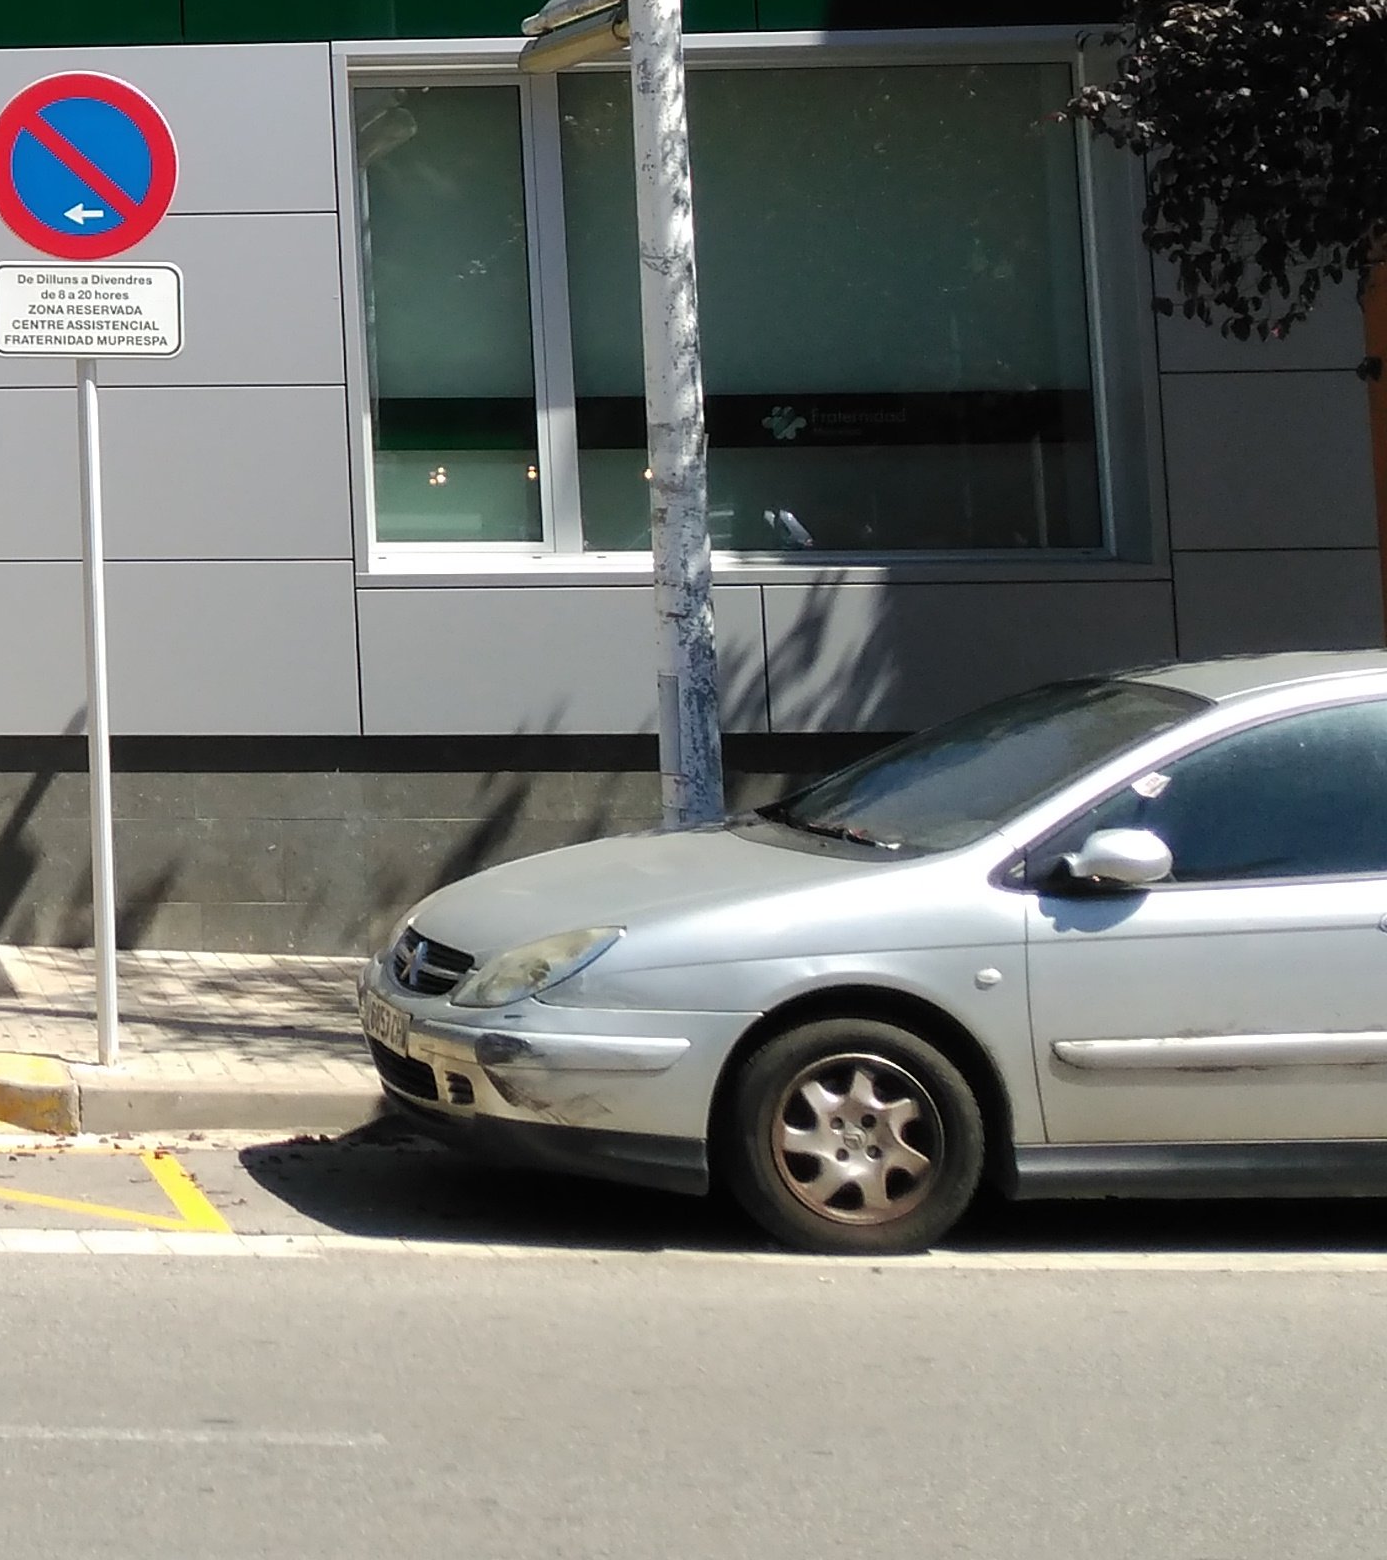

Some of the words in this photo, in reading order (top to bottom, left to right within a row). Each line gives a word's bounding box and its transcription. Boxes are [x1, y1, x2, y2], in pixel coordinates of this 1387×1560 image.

[18, 274, 34, 285] De
[36, 274, 79, 285] Dilluns
[81, 277, 88, 285] a
[91, 274, 153, 285] Divendres
[41, 290, 56, 300] de
[58, 290, 65, 300] 8
[68, 292, 76, 300] a
[78, 290, 92, 300] 20
[95, 290, 129, 300] hores
[28, 305, 64, 315] ZONA
[66, 305, 143, 315] RESERVADA
[12, 320, 64, 330] CENTRE
[66, 320, 159, 331] ASSISTENCIAL
[5, 335, 93, 345] FRATERNIDAD
[97, 335, 168, 347] MUPRESPA
